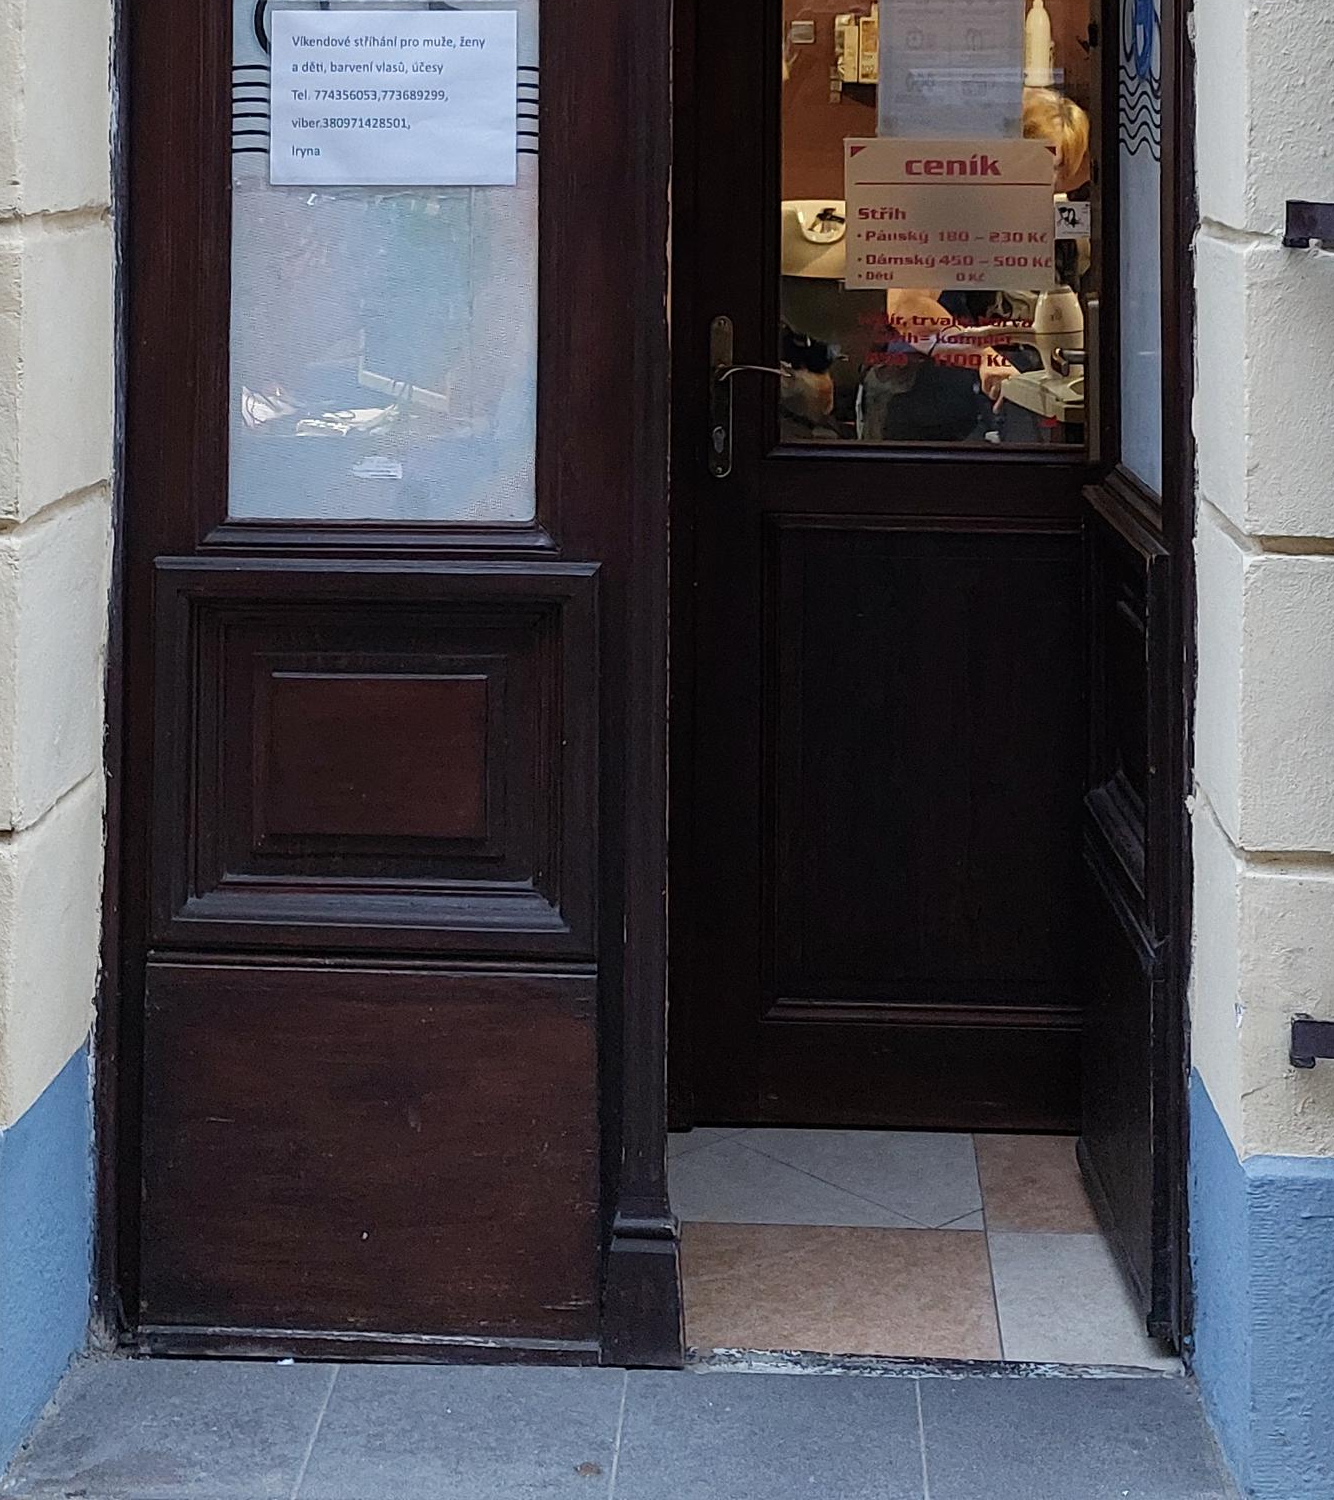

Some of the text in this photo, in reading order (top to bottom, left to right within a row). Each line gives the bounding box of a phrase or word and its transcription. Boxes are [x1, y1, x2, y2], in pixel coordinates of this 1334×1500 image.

[291, 35, 486, 50] Víkendové stříhání pro muže, ženy
[292, 61, 444, 75] a děti, barvení vlasů, účesy
[290, 89, 311, 101] Tel.
[292, 145, 321, 159] Iryna
[905, 154, 1003, 177] ceník
[938, 231, 971, 243] 180
[988, 231, 1024, 243] 230
[938, 254, 975, 267] 450
[993, 255, 1029, 268] 500
